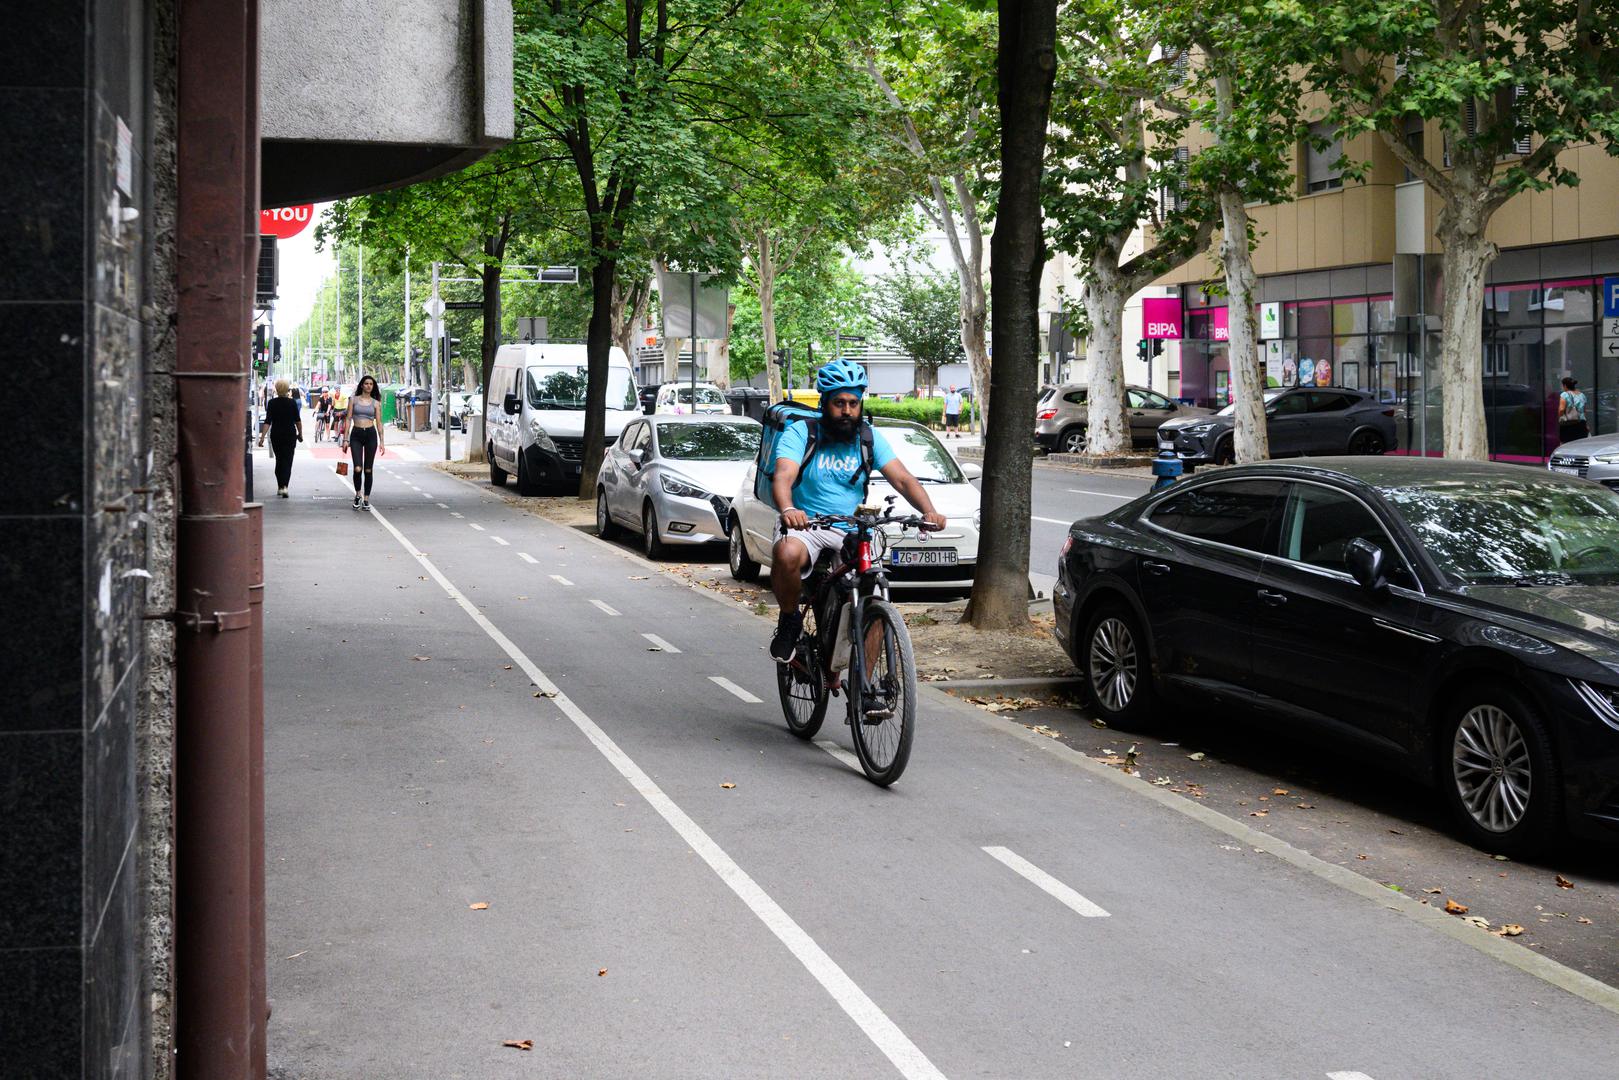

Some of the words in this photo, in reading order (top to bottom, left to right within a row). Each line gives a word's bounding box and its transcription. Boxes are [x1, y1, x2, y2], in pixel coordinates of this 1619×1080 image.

[271, 207, 308, 222] YOU
[1148, 323, 1178, 336] BIPA
[818, 452, 859, 472] Wolt
[900, 552, 912, 563] ZG
